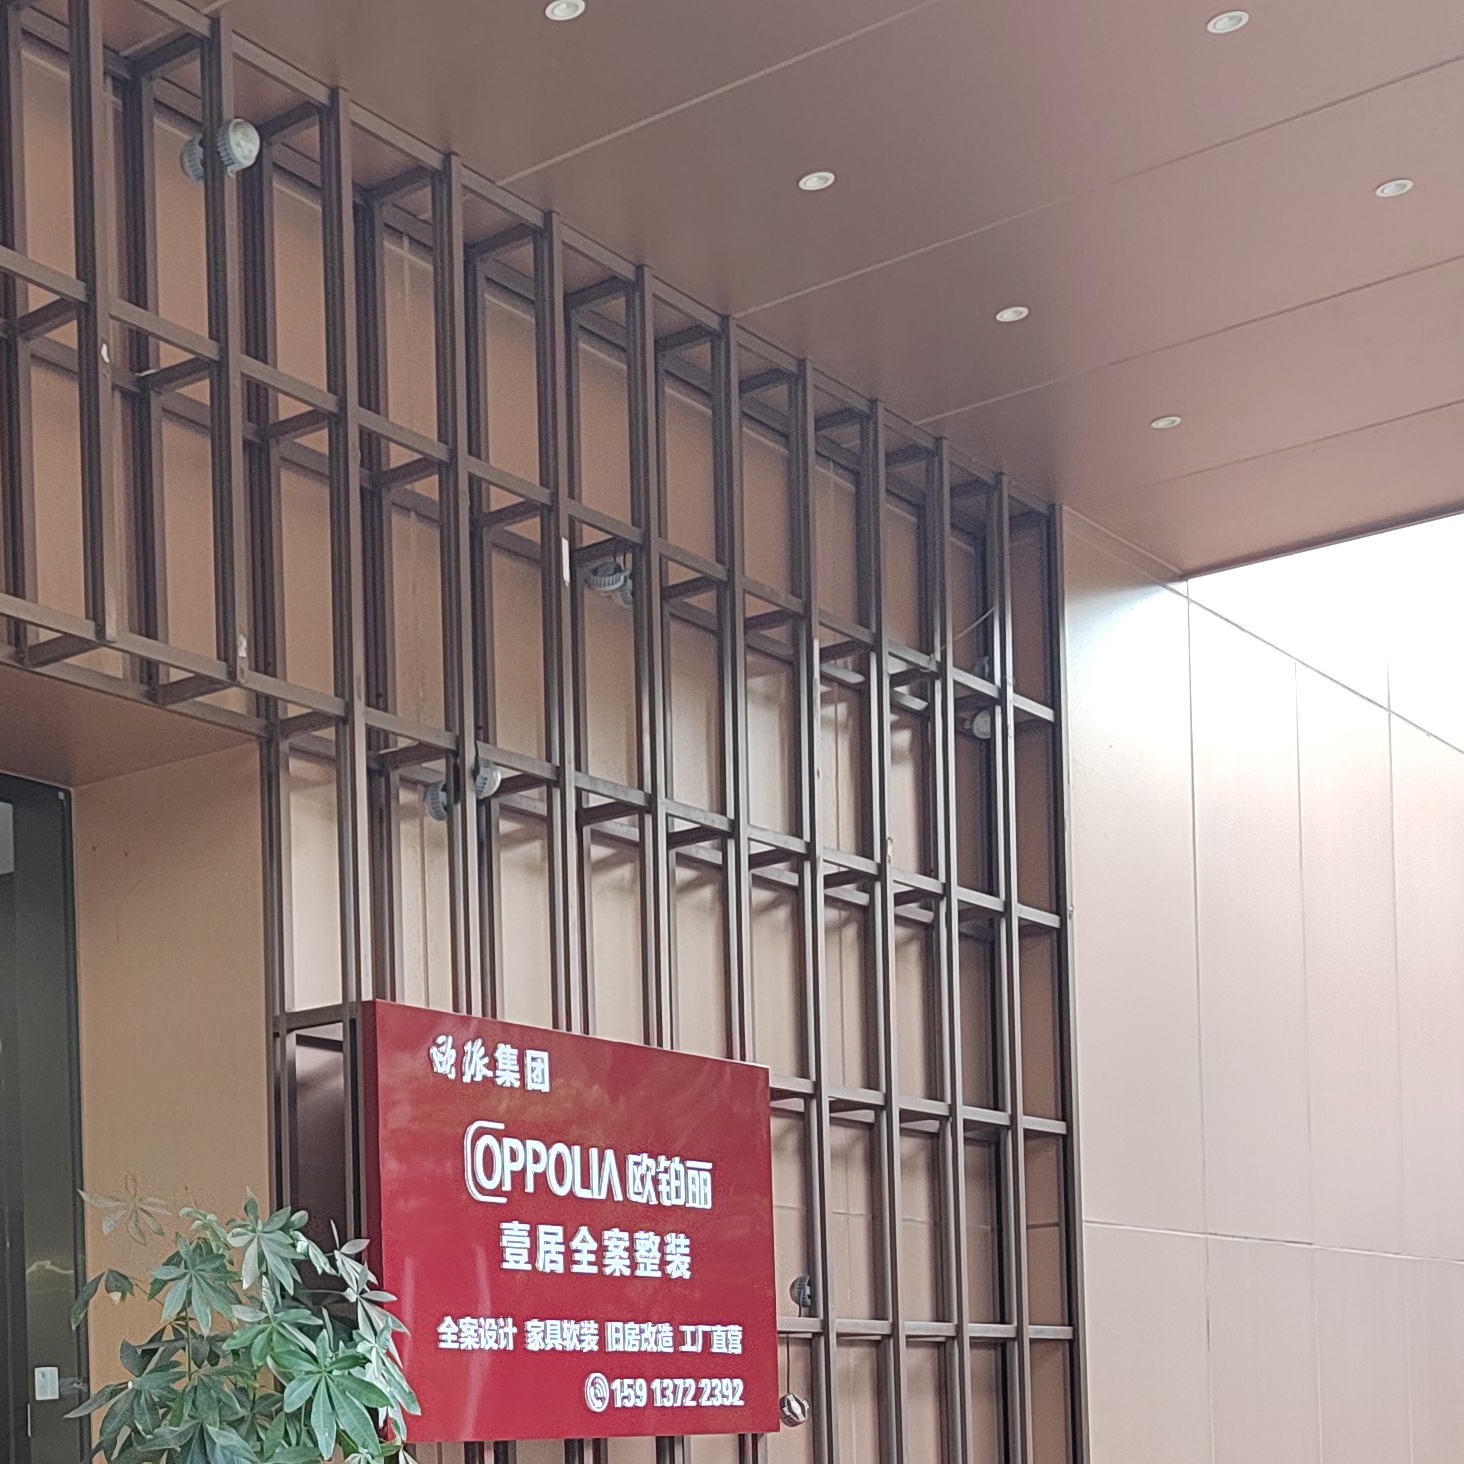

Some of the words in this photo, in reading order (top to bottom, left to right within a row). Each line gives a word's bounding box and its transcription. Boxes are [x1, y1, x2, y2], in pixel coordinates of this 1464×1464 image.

[626, 1152, 713, 1210] 欧铂丽
[499, 1221, 692, 1280] 壹居全案整装
[437, 1315, 517, 1350] 全案设计
[525, 1319, 599, 1353] 家具软装
[605, 1322, 674, 1353] 旧房改造
[678, 1324, 744, 1355] 工厂直营
[610, 1378, 647, 1408] 159
[650, 1378, 697, 1408] 1372
[698, 1378, 745, 1407] 2392
